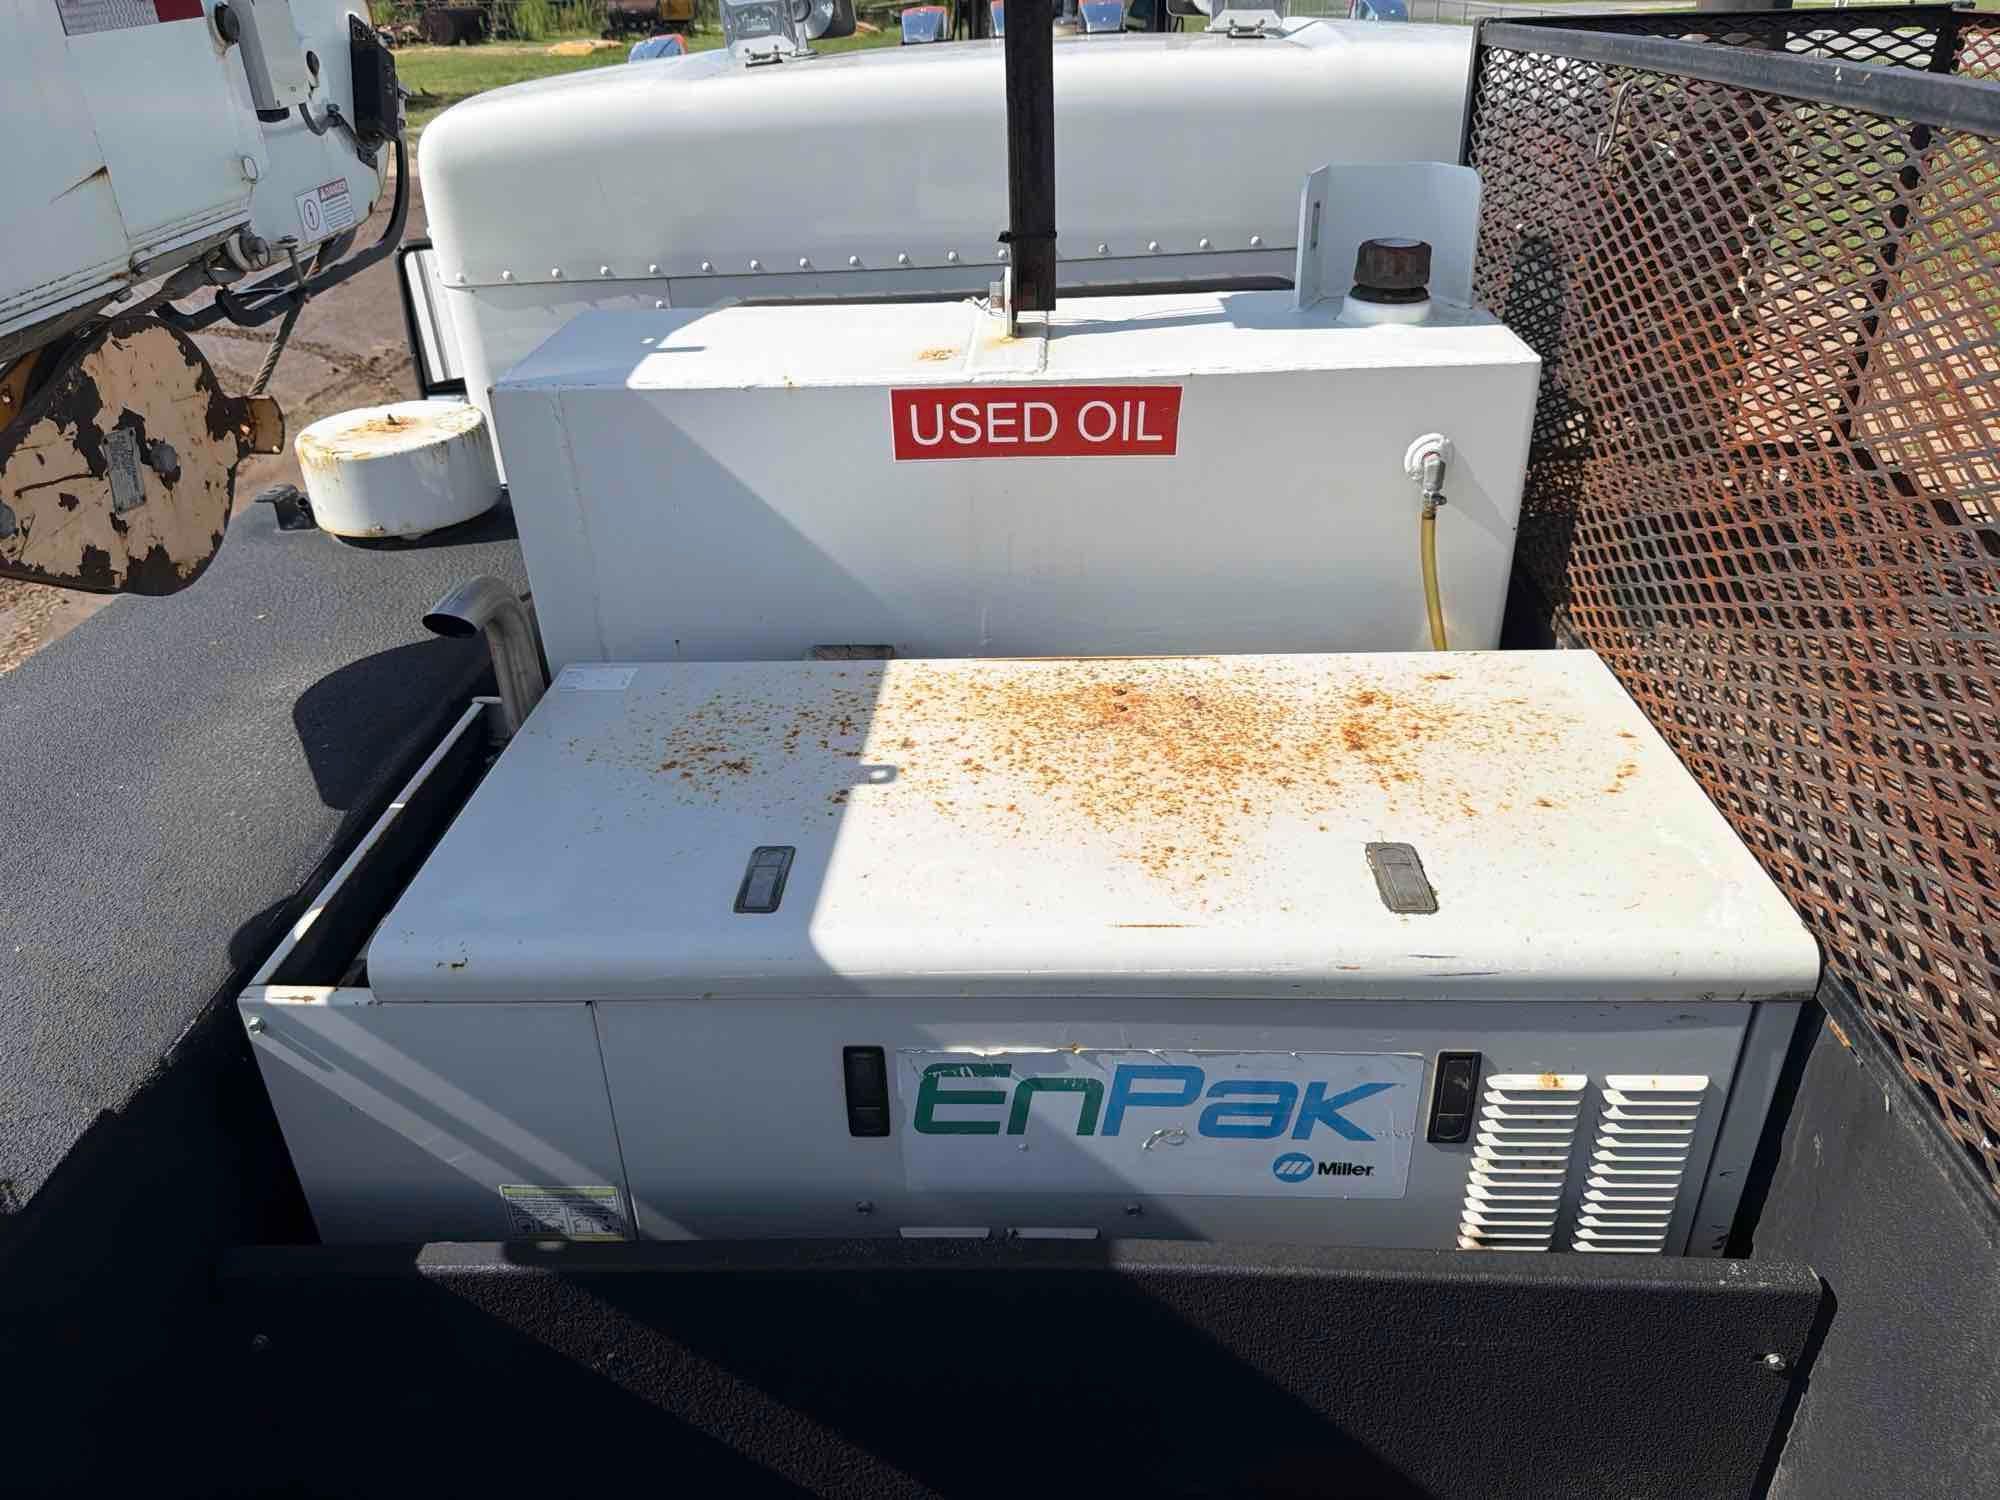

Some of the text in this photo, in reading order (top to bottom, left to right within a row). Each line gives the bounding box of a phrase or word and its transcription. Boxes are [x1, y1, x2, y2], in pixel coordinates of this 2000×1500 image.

[909, 399, 1164, 446] USED OIL
[913, 1062, 1406, 1142] EnPak
[1317, 1161, 1375, 1177] Miller
